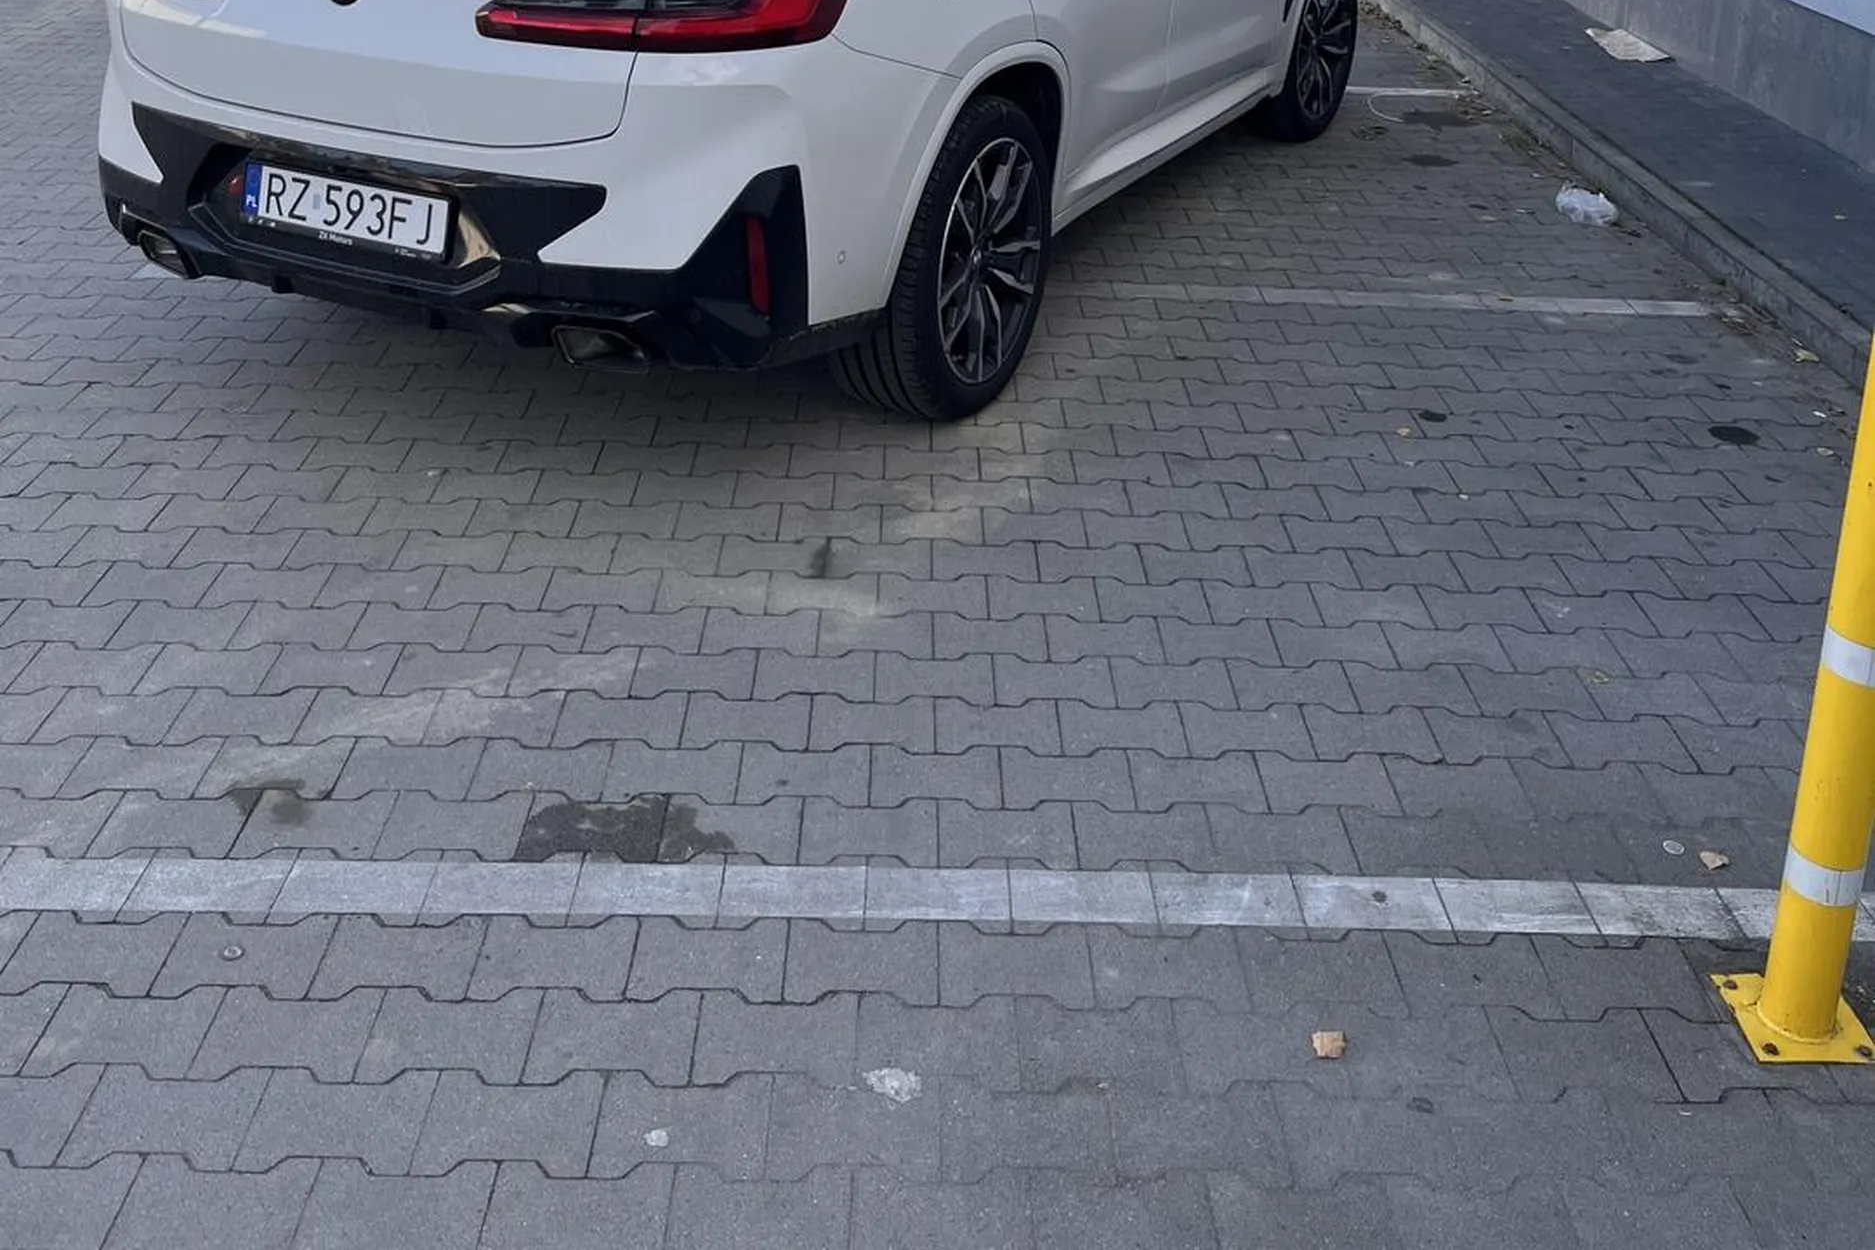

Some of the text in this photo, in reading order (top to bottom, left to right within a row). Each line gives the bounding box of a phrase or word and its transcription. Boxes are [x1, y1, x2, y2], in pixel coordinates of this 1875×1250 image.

[245, 194, 258, 208] PL
[265, 173, 433, 245] RZ 593FJ
